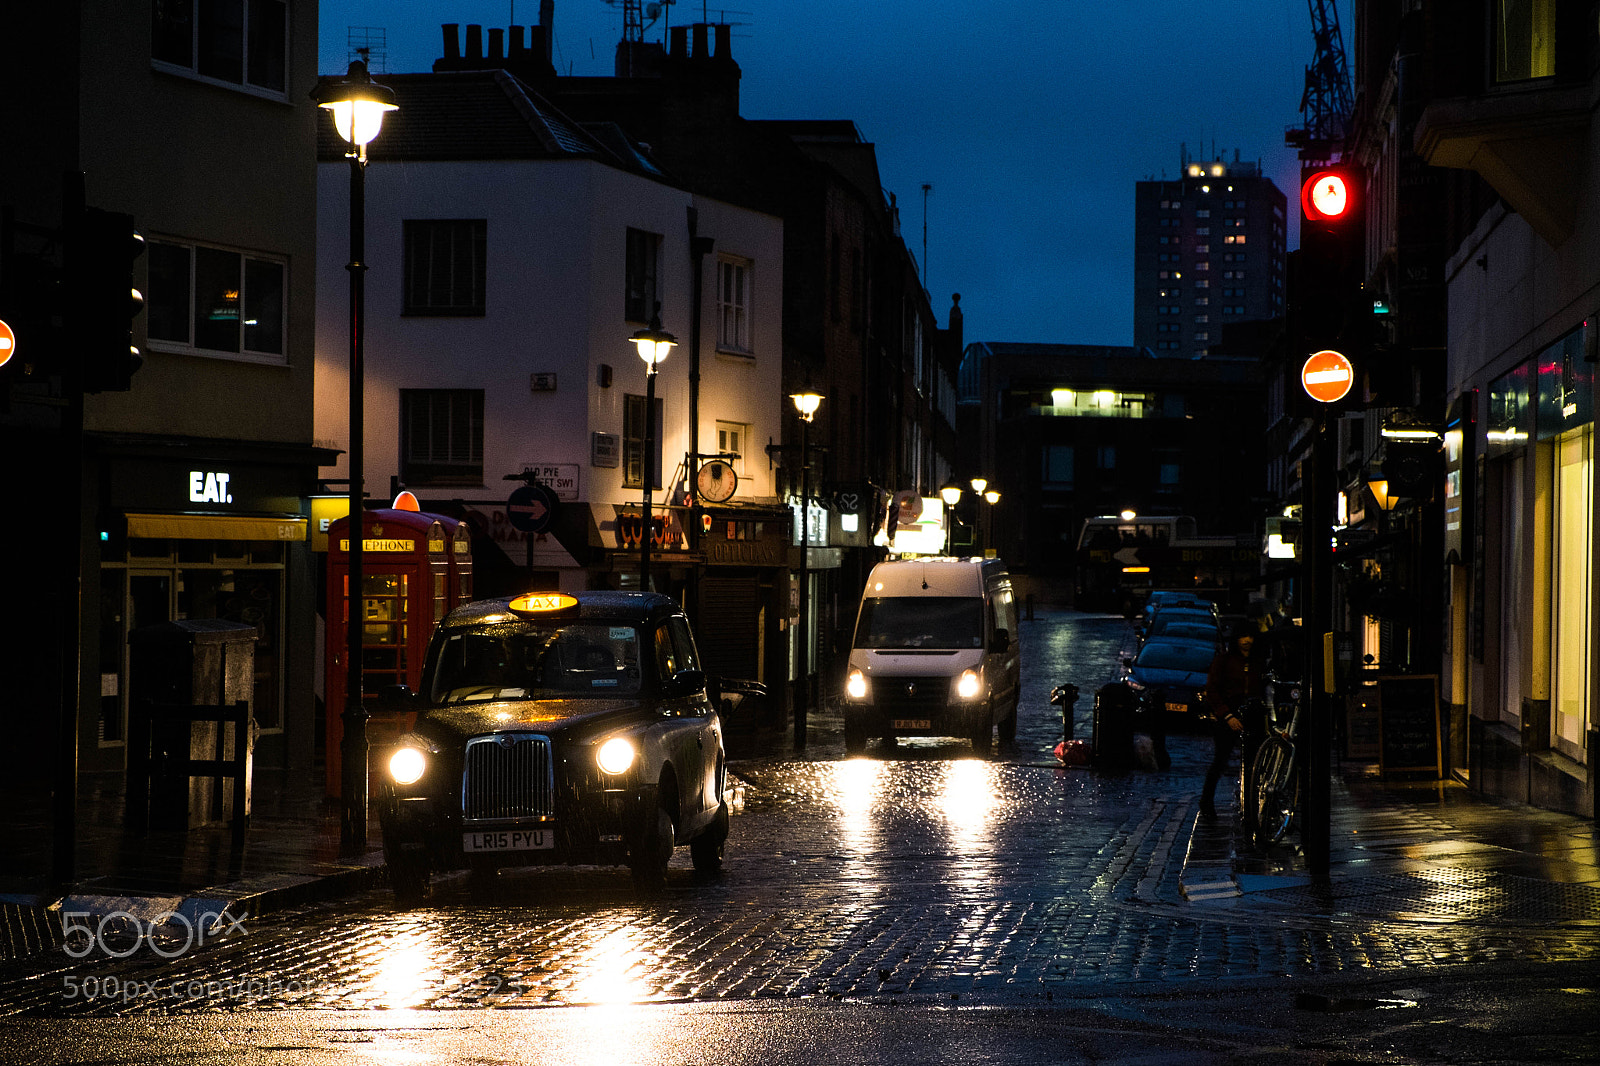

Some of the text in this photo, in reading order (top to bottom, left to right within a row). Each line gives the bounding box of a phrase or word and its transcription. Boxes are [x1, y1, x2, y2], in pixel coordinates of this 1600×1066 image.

[543, 467, 559, 477] PYE
[189, 471, 233, 504] EAT.
[557, 479, 573, 488] SW1
[620, 512, 665, 544] COO
[344, 540, 412, 550] TEPHONE
[523, 597, 562, 610] TAXI
[473, 831, 544, 848] LR15 PYU
